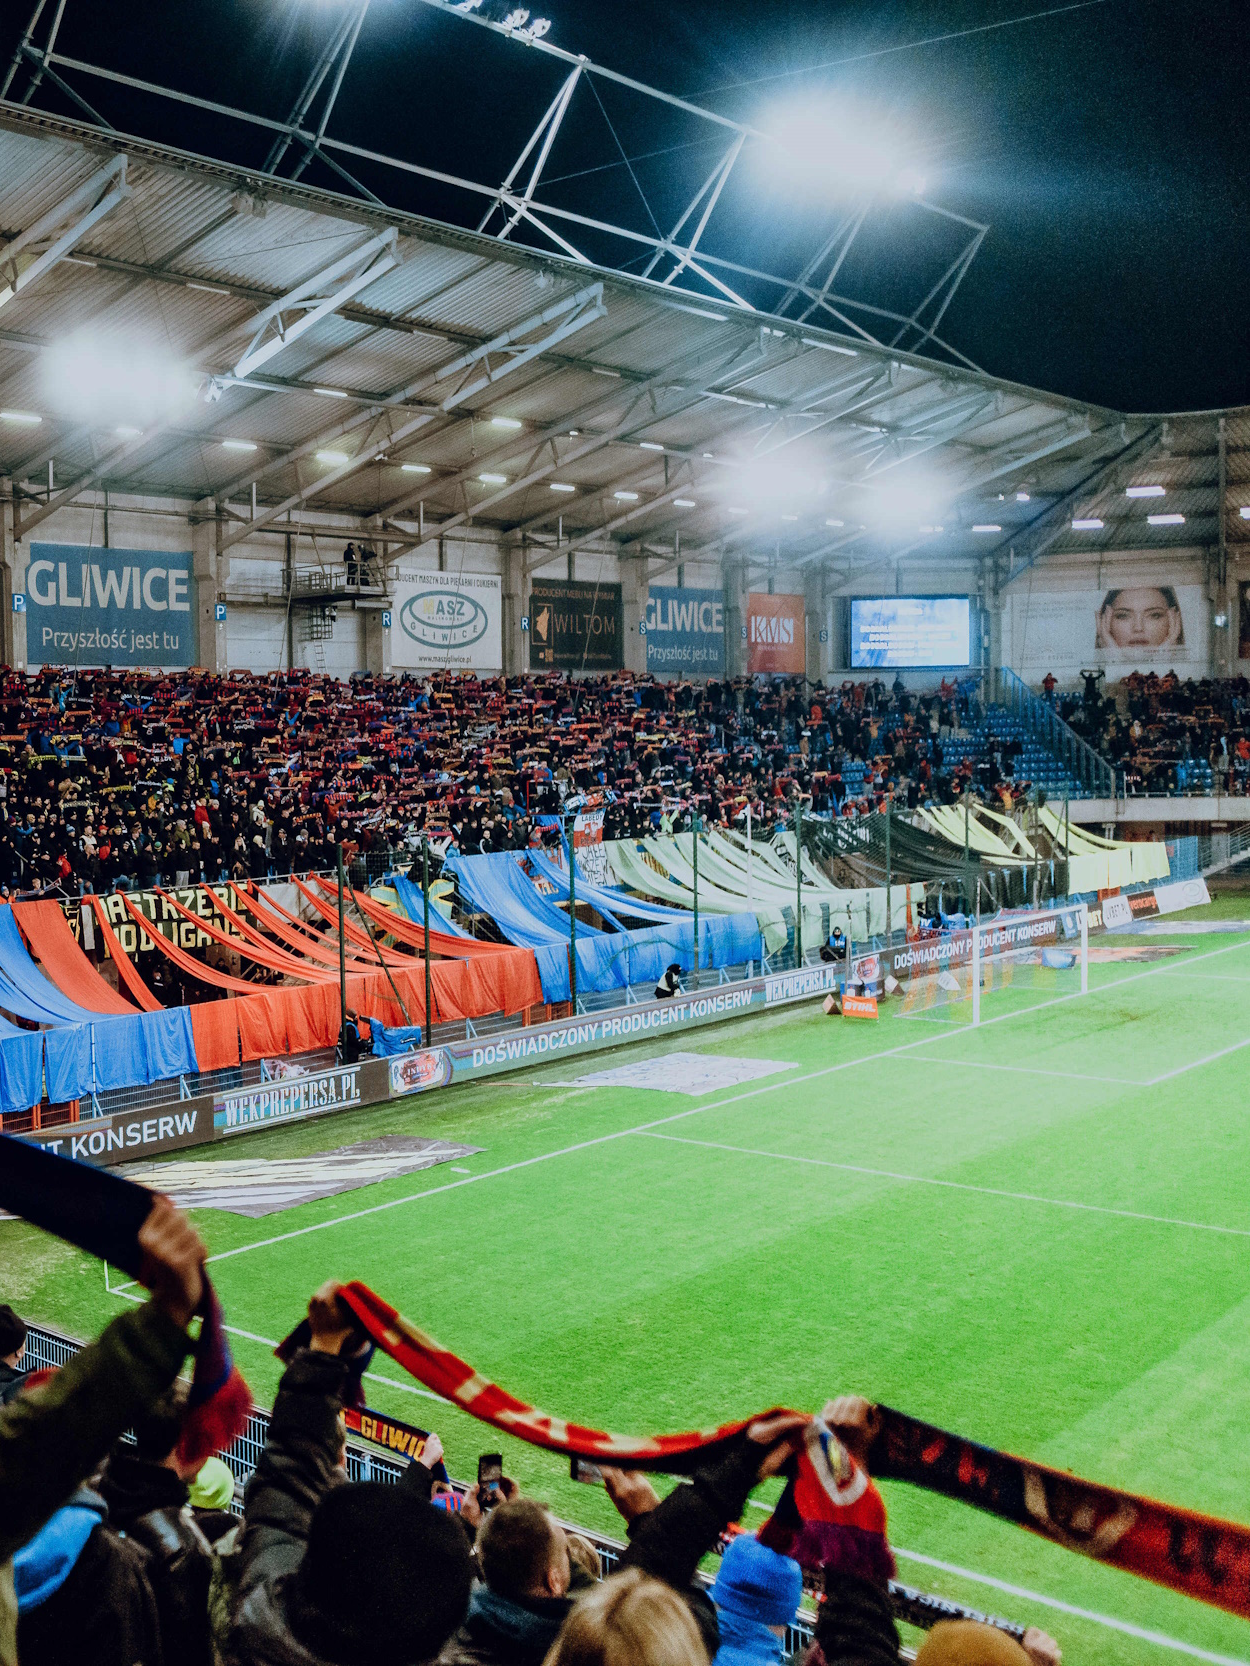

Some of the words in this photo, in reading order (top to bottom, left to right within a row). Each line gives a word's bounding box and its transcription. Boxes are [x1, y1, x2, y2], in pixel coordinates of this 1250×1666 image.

[27, 559, 191, 611] GLIWICE
[14, 595, 24, 611] P
[216, 605, 225, 620] P
[423, 598, 465, 616] MASZ
[383, 612, 391, 625] R
[521, 617, 529, 630] R
[554, 613, 615, 635] WILTOM
[645, 597, 724, 633] GLIWICE
[410, 621, 478, 642] GLIWICE
[640, 622, 646, 634] S
[42, 627, 126, 652] Przyszłość
[129, 630, 160, 653] jest
[163, 631, 179, 650] tu
[648, 644, 692, 662] Przyszłość
[894, 939, 965, 970] DOŚWIADCZONY
[966, 929, 1017, 955] PODUCENT
[1018, 920, 1057, 942] KONSERW
[472, 1022, 599, 1069] DOŚWIADCZONY
[601, 1003, 687, 1039] PRODUCENT
[689, 989, 754, 1019] KONSERW
[71, 1110, 198, 1160] KONSERW
[224, 1072, 361, 1127] WEKPREPERSA.PL
[361, 1414, 427, 1462] GLIWIC
